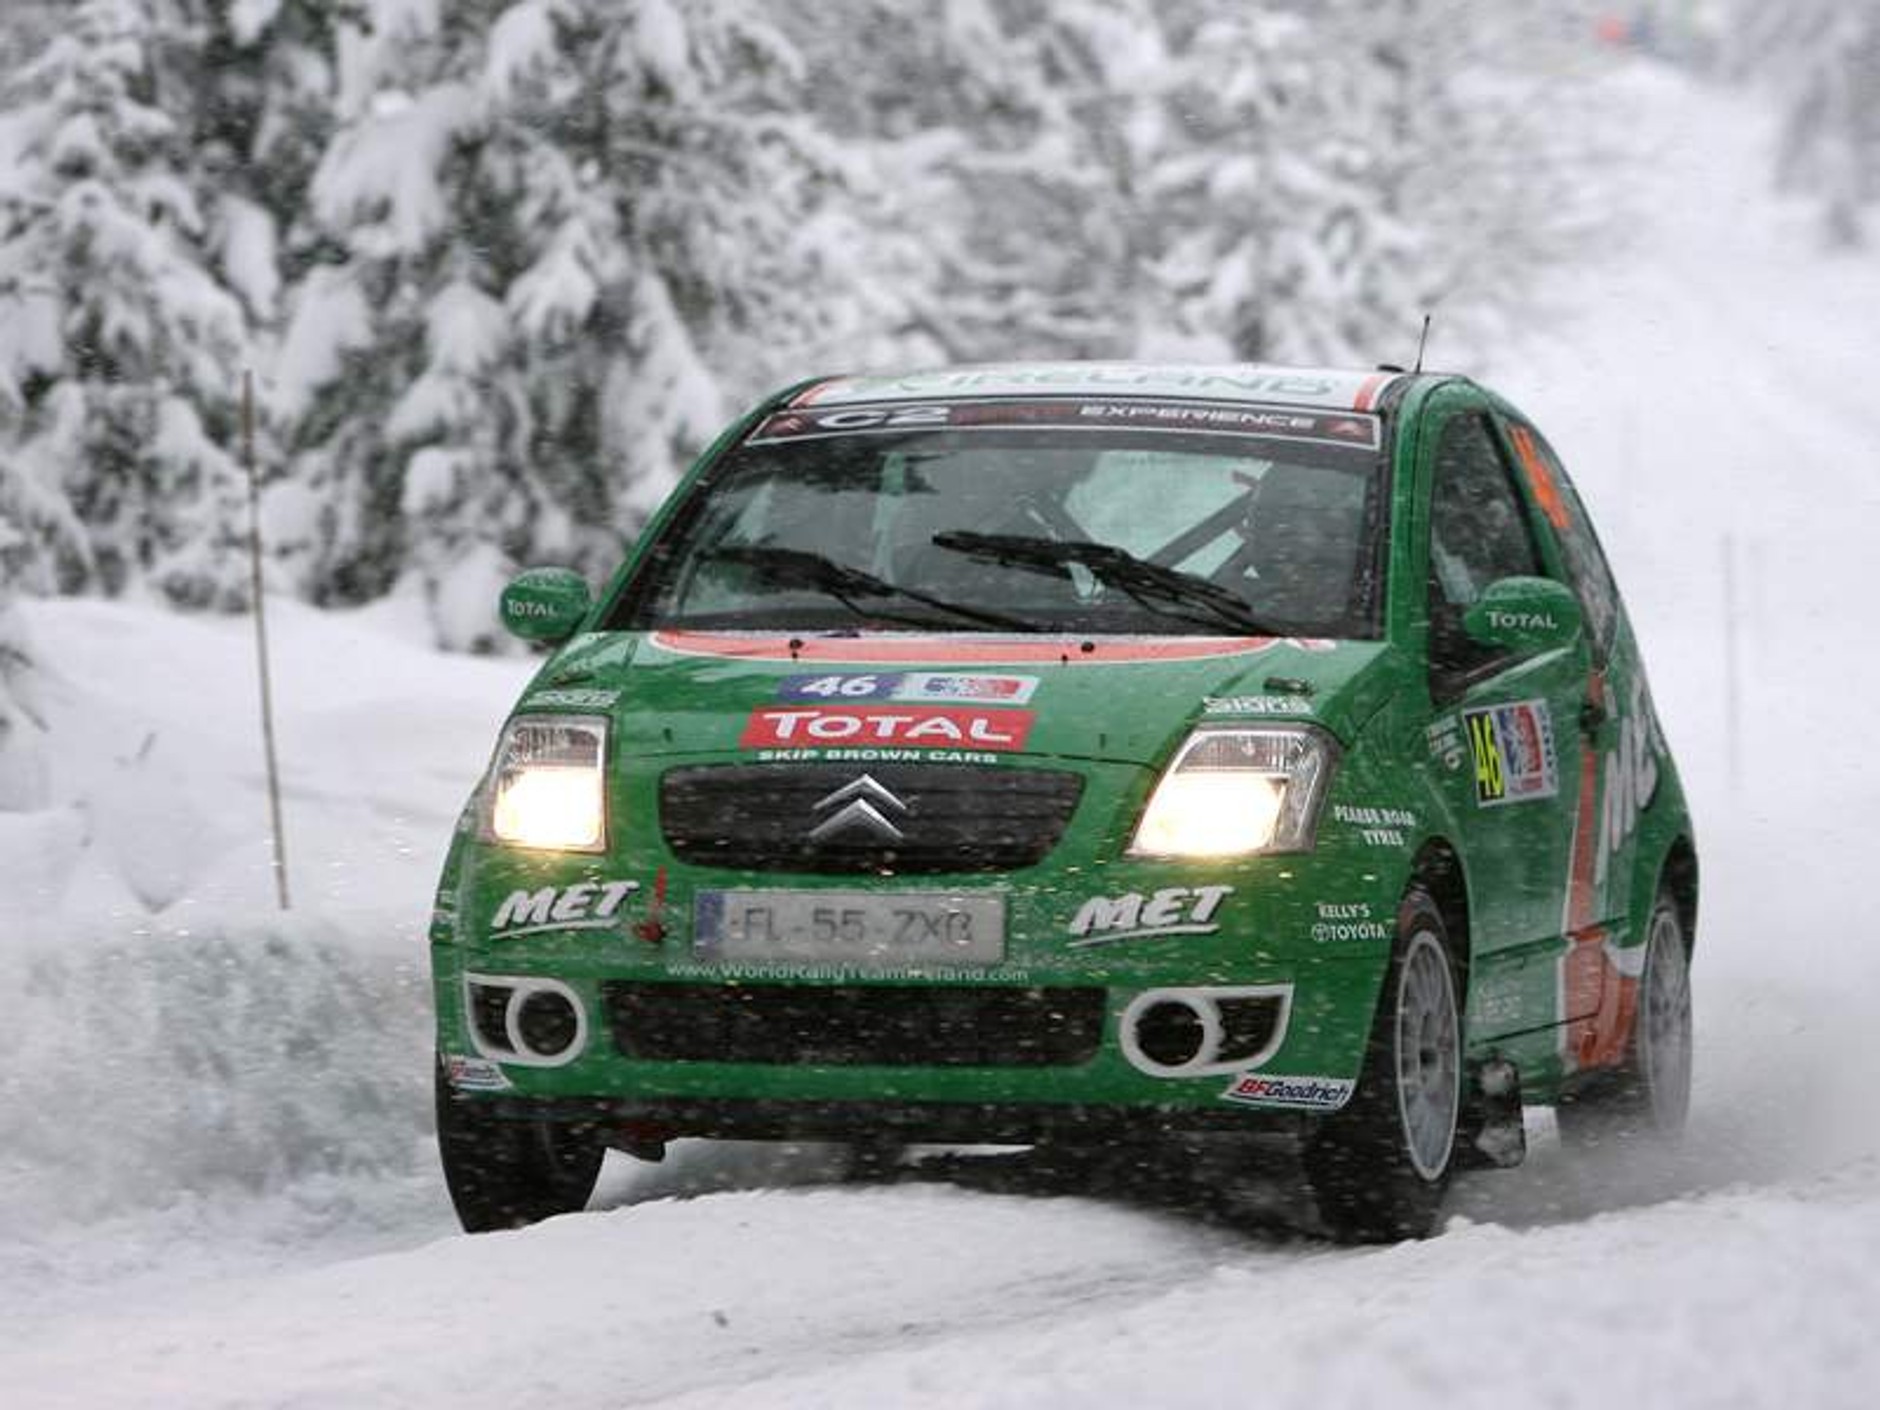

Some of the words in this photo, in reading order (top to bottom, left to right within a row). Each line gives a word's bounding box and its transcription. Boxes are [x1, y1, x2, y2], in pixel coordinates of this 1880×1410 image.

[816, 406, 949, 429] C2
[1080, 404, 1316, 429] EXPERIENCE
[508, 599, 558, 617] TOTAL
[1485, 610, 1559, 630] TOTAL
[800, 674, 879, 697] 46
[763, 710, 1012, 743] TOTAL
[757, 749, 819, 762] SKIP
[825, 749, 921, 762] BROWN
[928, 750, 998, 764] CARS
[490, 880, 641, 930] MET
[1067, 885, 1236, 936] MET
[1329, 924, 1388, 941] TOYOTA
[1237, 1077, 1350, 1102] BFGoodrich
